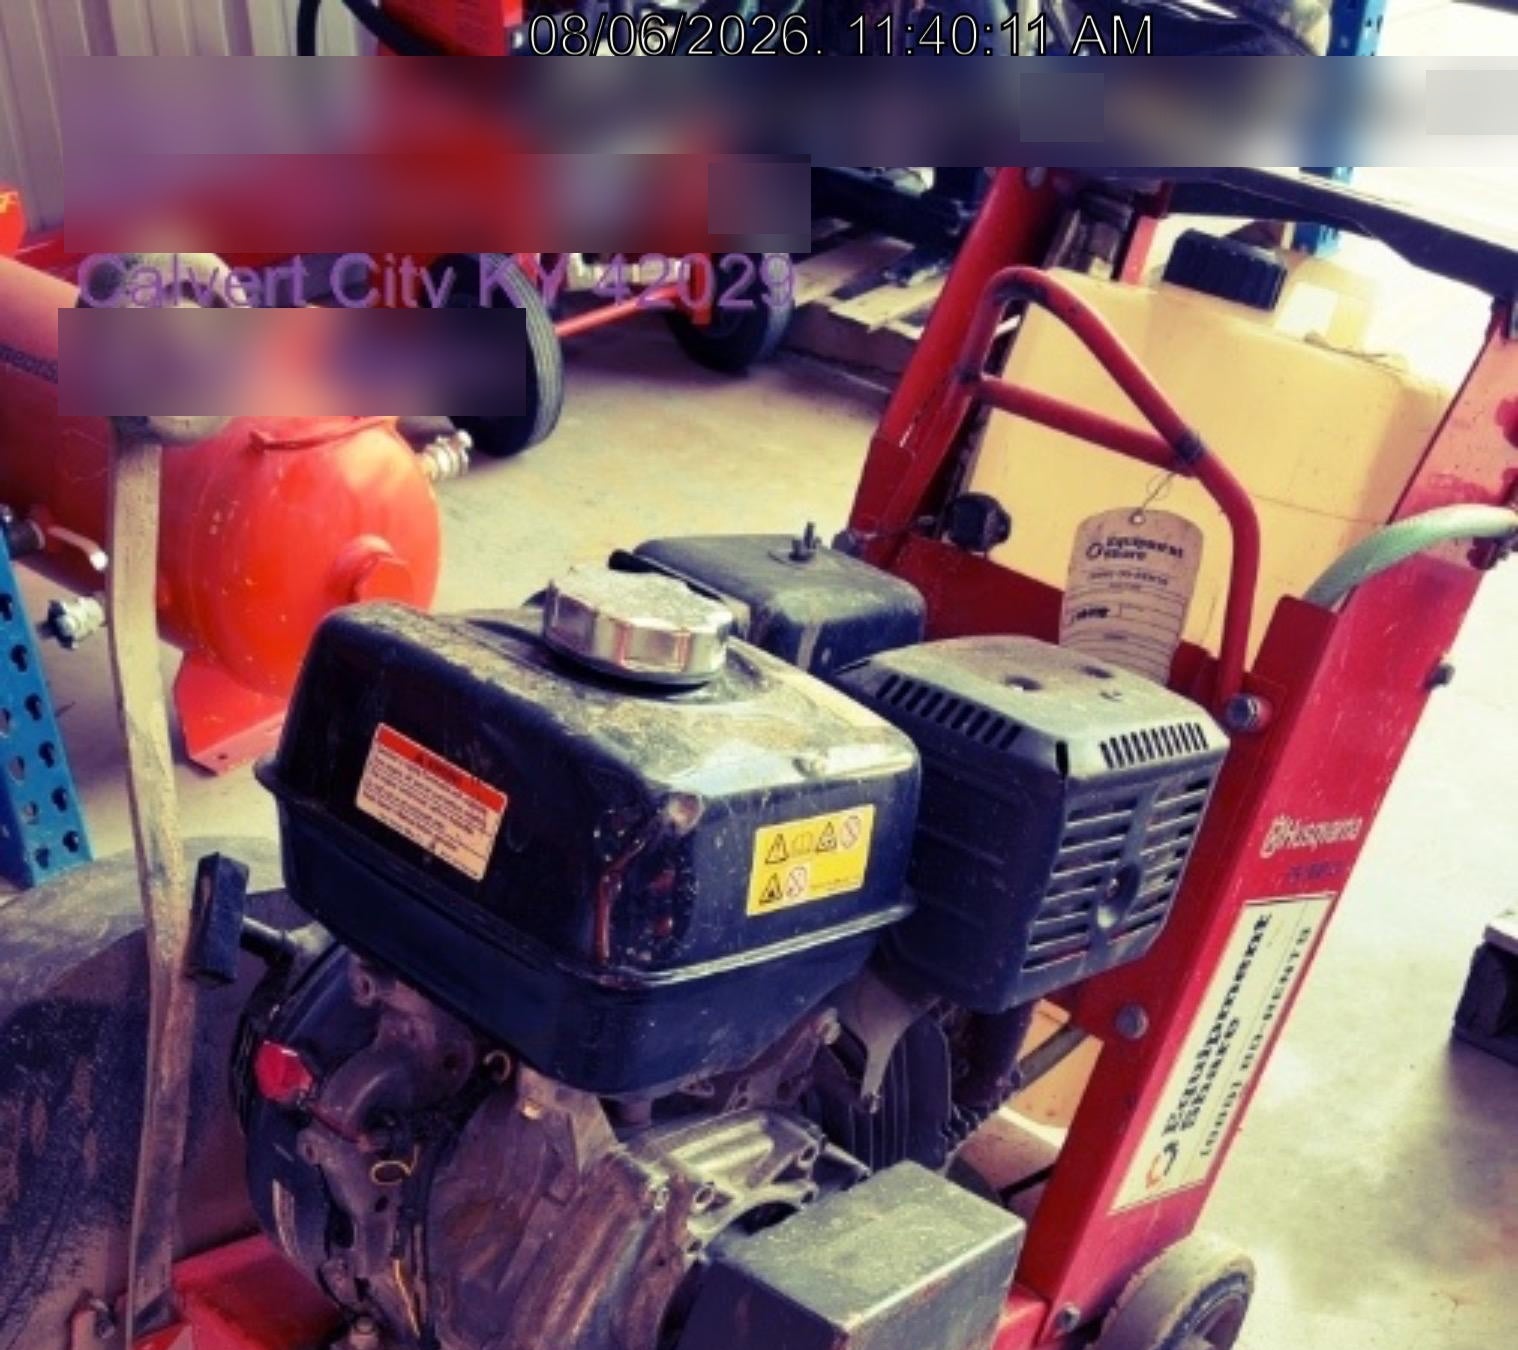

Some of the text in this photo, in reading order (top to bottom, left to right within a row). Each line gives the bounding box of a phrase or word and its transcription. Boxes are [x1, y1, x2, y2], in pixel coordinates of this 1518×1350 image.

[1284, 818, 1363, 852] Husqvarna
[1163, 913, 1273, 1136] Equipment
[1180, 1016, 1240, 1131] Share
